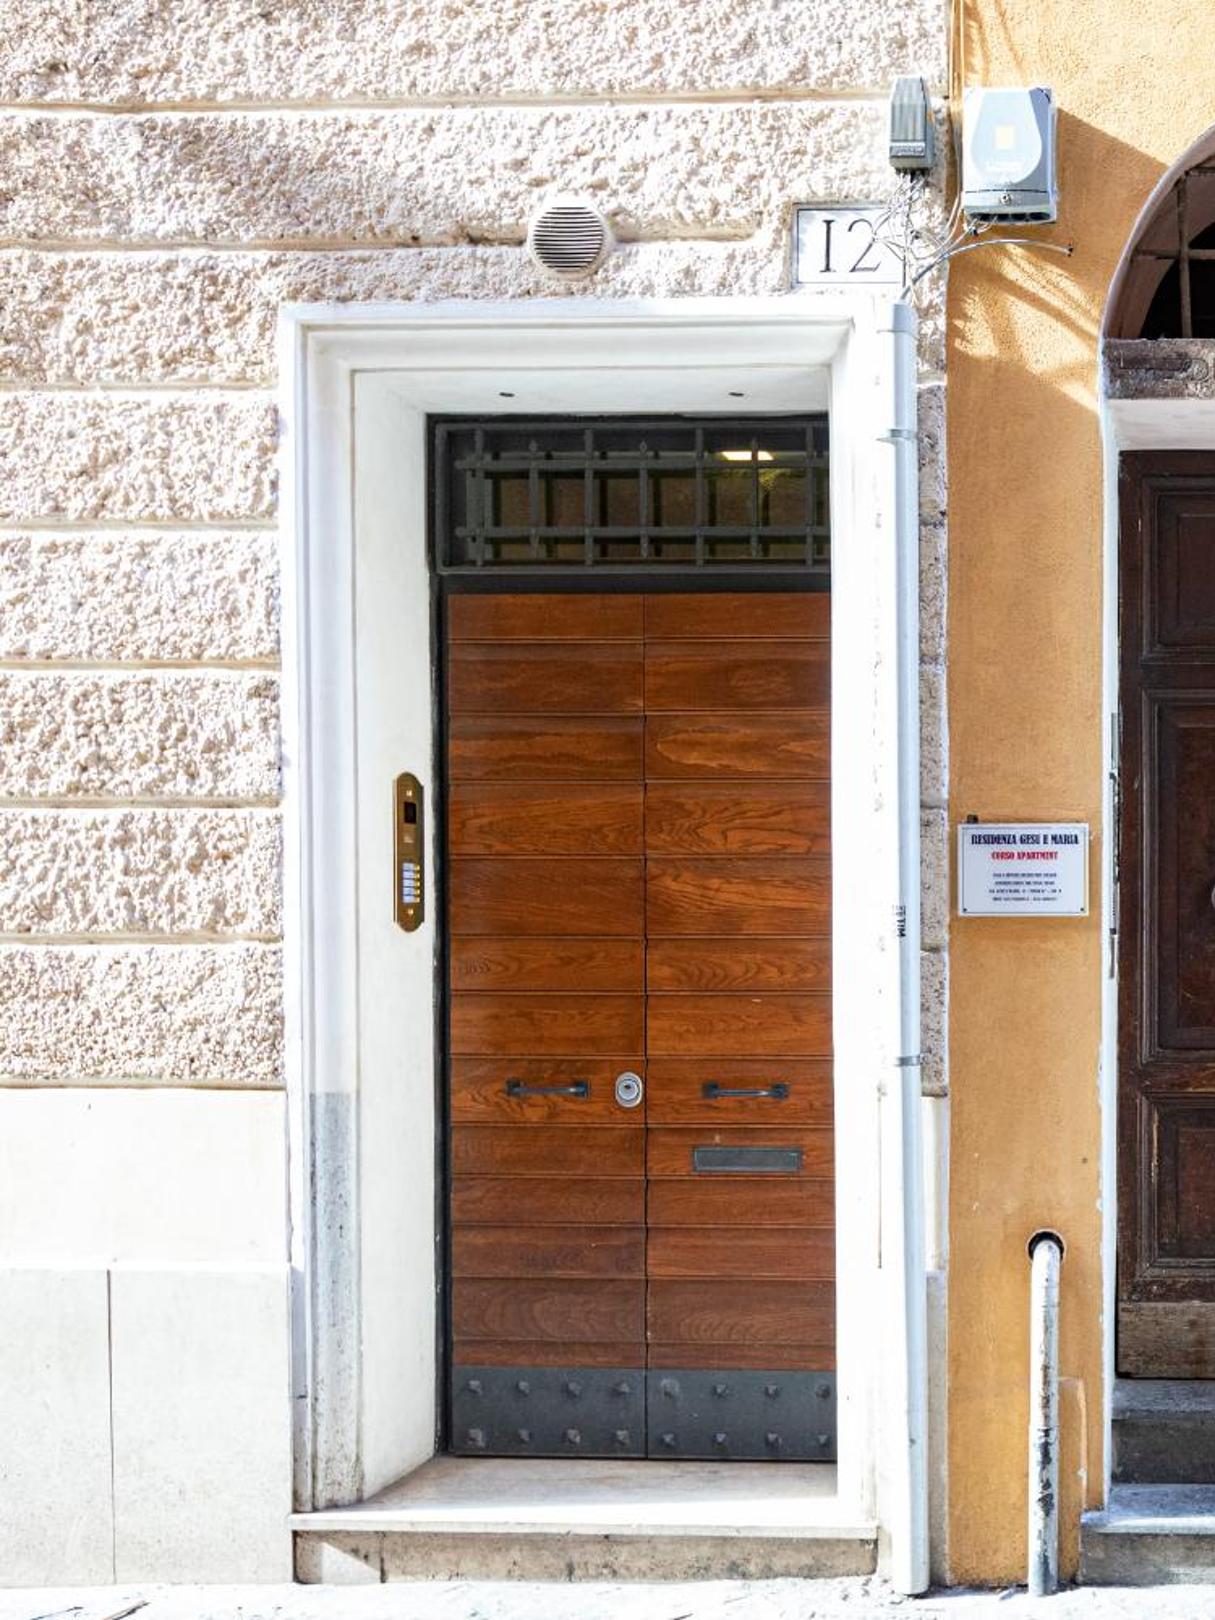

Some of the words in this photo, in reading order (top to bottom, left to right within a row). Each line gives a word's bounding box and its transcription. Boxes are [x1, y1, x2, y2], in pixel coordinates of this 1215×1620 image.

[820, 219, 882, 273] 12
[971, 834, 1017, 845] RESIDENZA
[1043, 834, 1048, 845] E
[1051, 834, 1079, 845] MARIA
[991, 851, 1015, 860] CORSO
